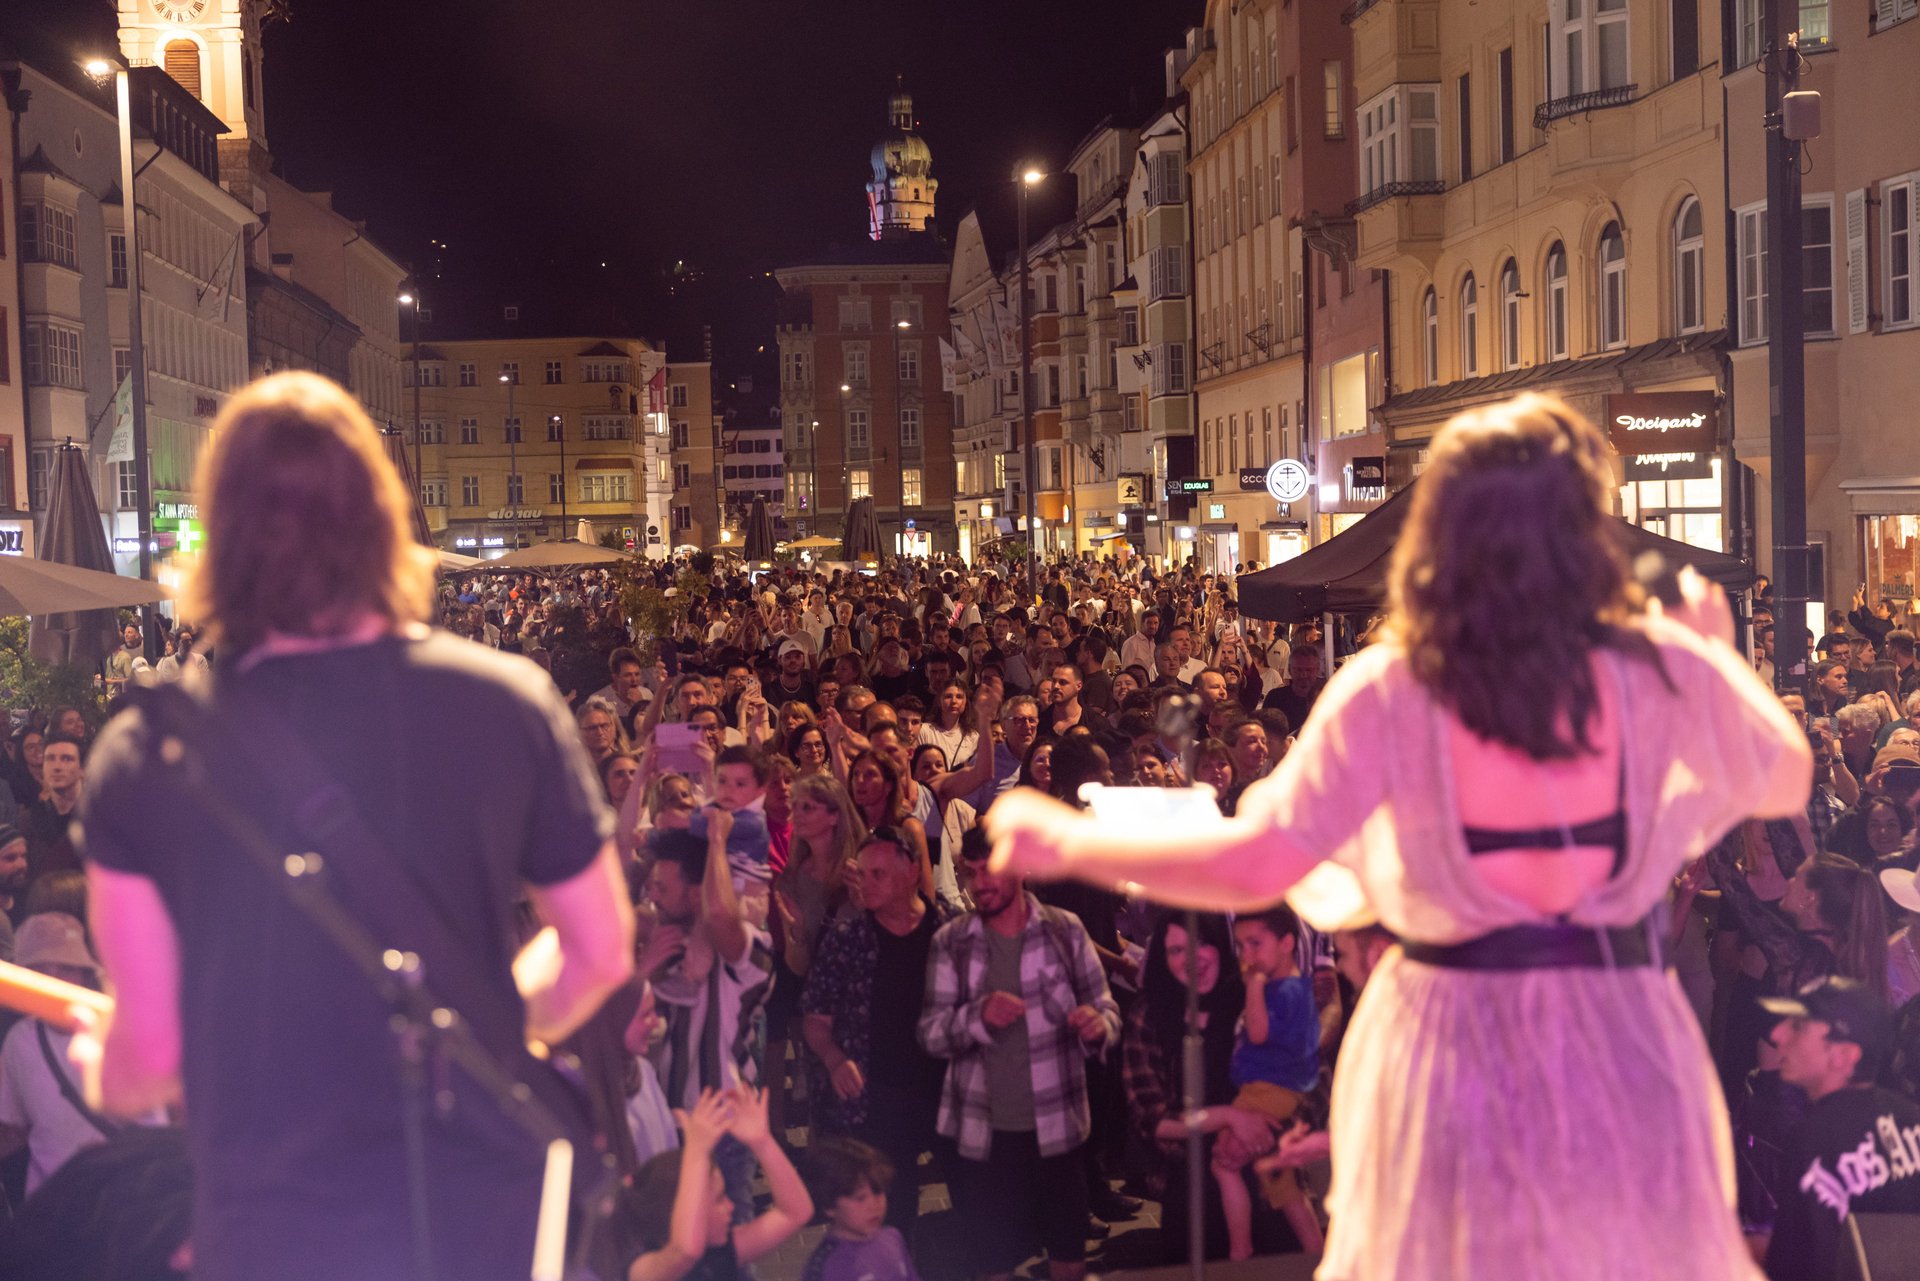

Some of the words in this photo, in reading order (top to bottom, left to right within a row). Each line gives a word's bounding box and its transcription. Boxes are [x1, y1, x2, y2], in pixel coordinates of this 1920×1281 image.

[1616, 412, 1706, 433] Weigand
[1183, 482, 1209, 490] DOUGLAS
[177, 504, 198, 519] APOTHEKE
[1882, 583, 1915, 597] PALMERS
[1800, 1131, 1890, 1223] Los
